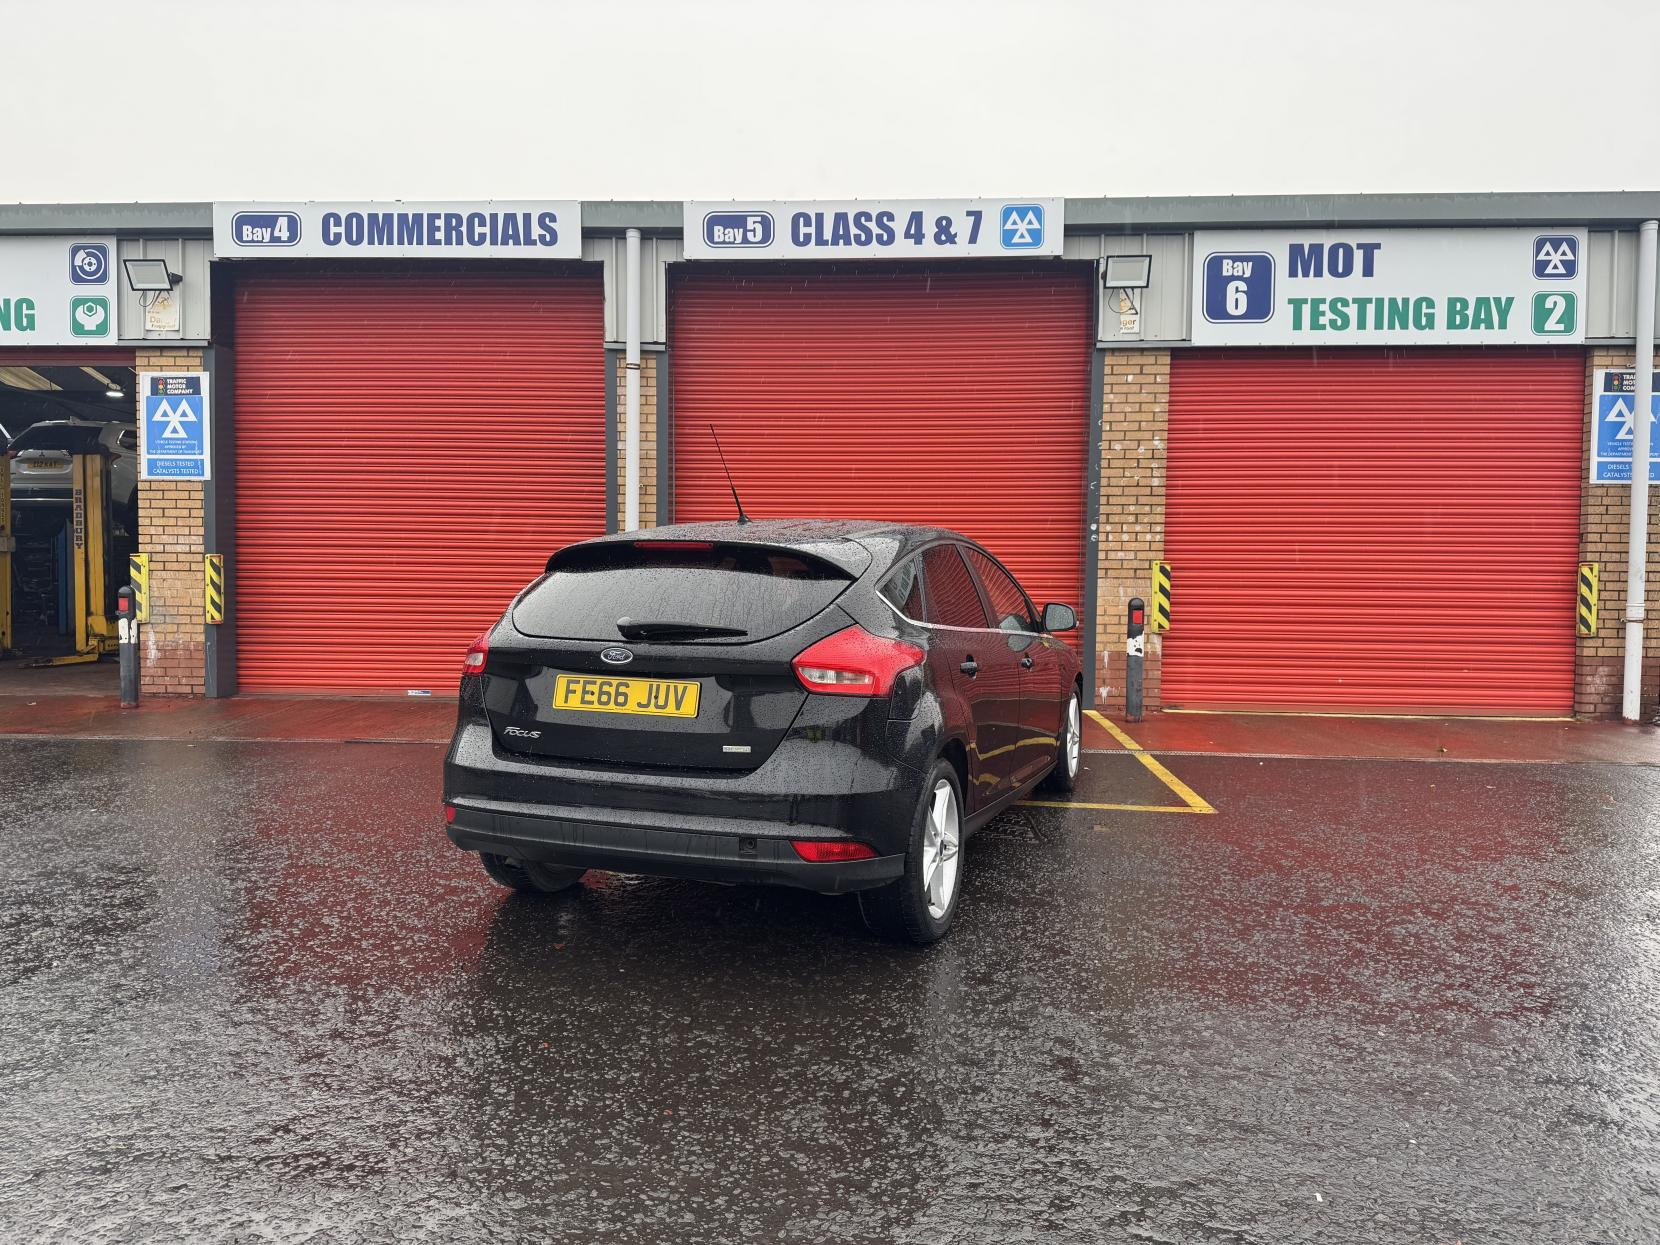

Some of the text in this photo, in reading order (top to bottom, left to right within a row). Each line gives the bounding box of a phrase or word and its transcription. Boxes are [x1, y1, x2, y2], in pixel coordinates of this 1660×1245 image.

[242, 216, 290, 242] Bay 4
[321, 211, 558, 247] COMMERCIALS
[713, 216, 763, 243] Bay 5
[791, 210, 983, 247] CLASS 4 & 7
[1222, 259, 1253, 278] Bay
[1288, 242, 1382, 279] MOT
[1226, 280, 1248, 316] 6
[1287, 296, 1515, 331] TESTING BAY
[1543, 295, 1566, 331] 2
[74, 489, 84, 550] BRADBURY
[563, 679, 689, 711] FE66 JUV
